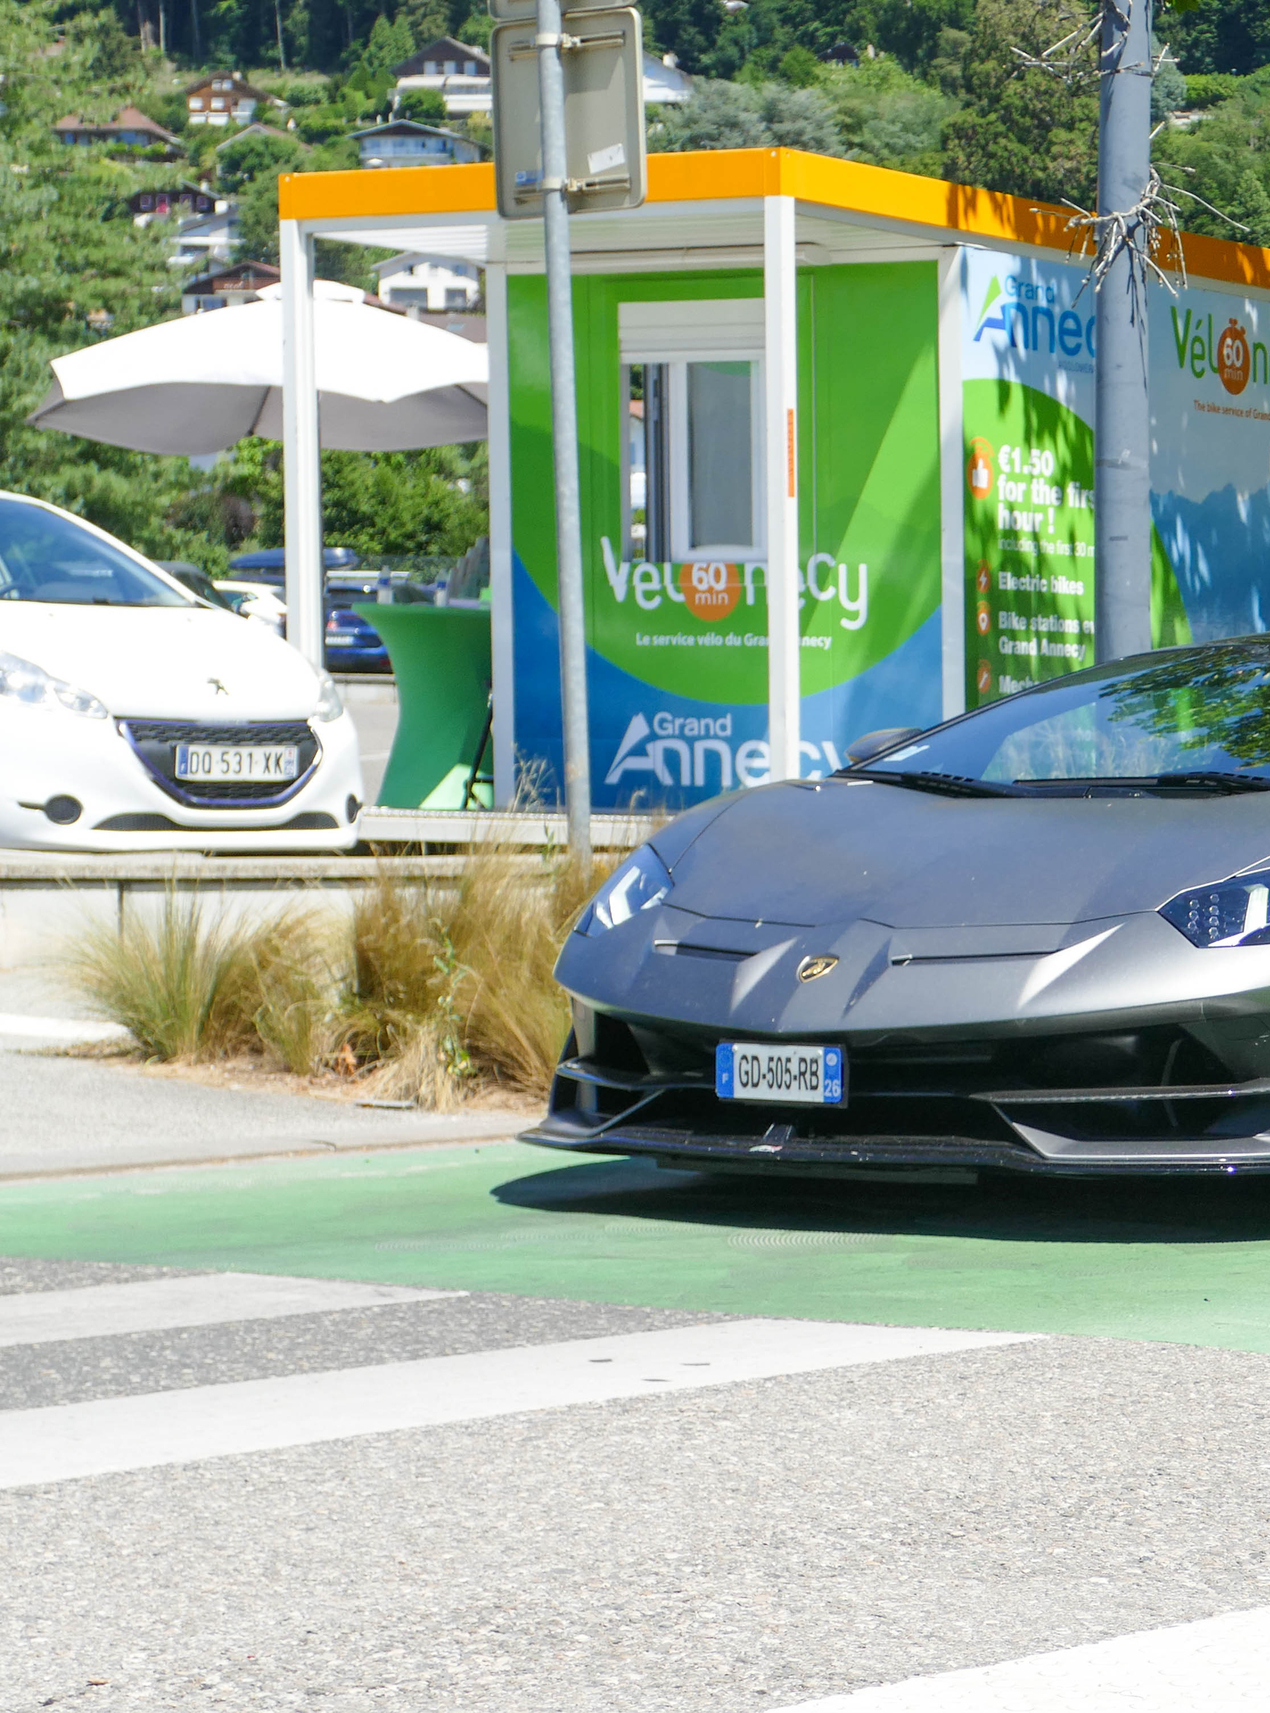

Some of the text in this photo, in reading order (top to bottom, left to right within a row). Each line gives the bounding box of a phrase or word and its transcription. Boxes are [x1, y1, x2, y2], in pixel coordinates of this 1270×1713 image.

[1005, 274, 1055, 303] Grand
[973, 275, 1095, 358] Anne
[1223, 337, 1243, 367] 60
[1224, 367, 1244, 381] min
[1194, 399, 1205, 411] The
[1207, 402, 1221, 413] bike
[1222, 406, 1244, 417] service
[1245, 407, 1252, 418] of
[998, 444, 1054, 476] €1.50
[997, 474, 1027, 502] for
[1031, 478, 1062, 506] the
[997, 502, 1043, 532] hour
[998, 535, 1039, 556] including
[1040, 538, 1055, 554] the
[1056, 539, 1074, 556] first
[1075, 541, 1087, 558] 30
[691, 563, 728, 591] 60
[998, 571, 1085, 596] Electric bikes
[694, 591, 729, 606] min
[999, 611, 1027, 631] Bike
[1030, 615, 1080, 634] stations
[636, 632, 652, 646] Le
[653, 632, 695, 646] service
[697, 632, 724, 646] vélo
[725, 632, 742, 646] du
[744, 633, 769, 647] Gra
[998, 636, 1086, 662] Grand Annecy
[653, 711, 732, 737] Grand
[722, 1073, 729, 1084] F
[738, 1054, 820, 1091] GD-505-RB
[824, 1078, 841, 1097] 26
